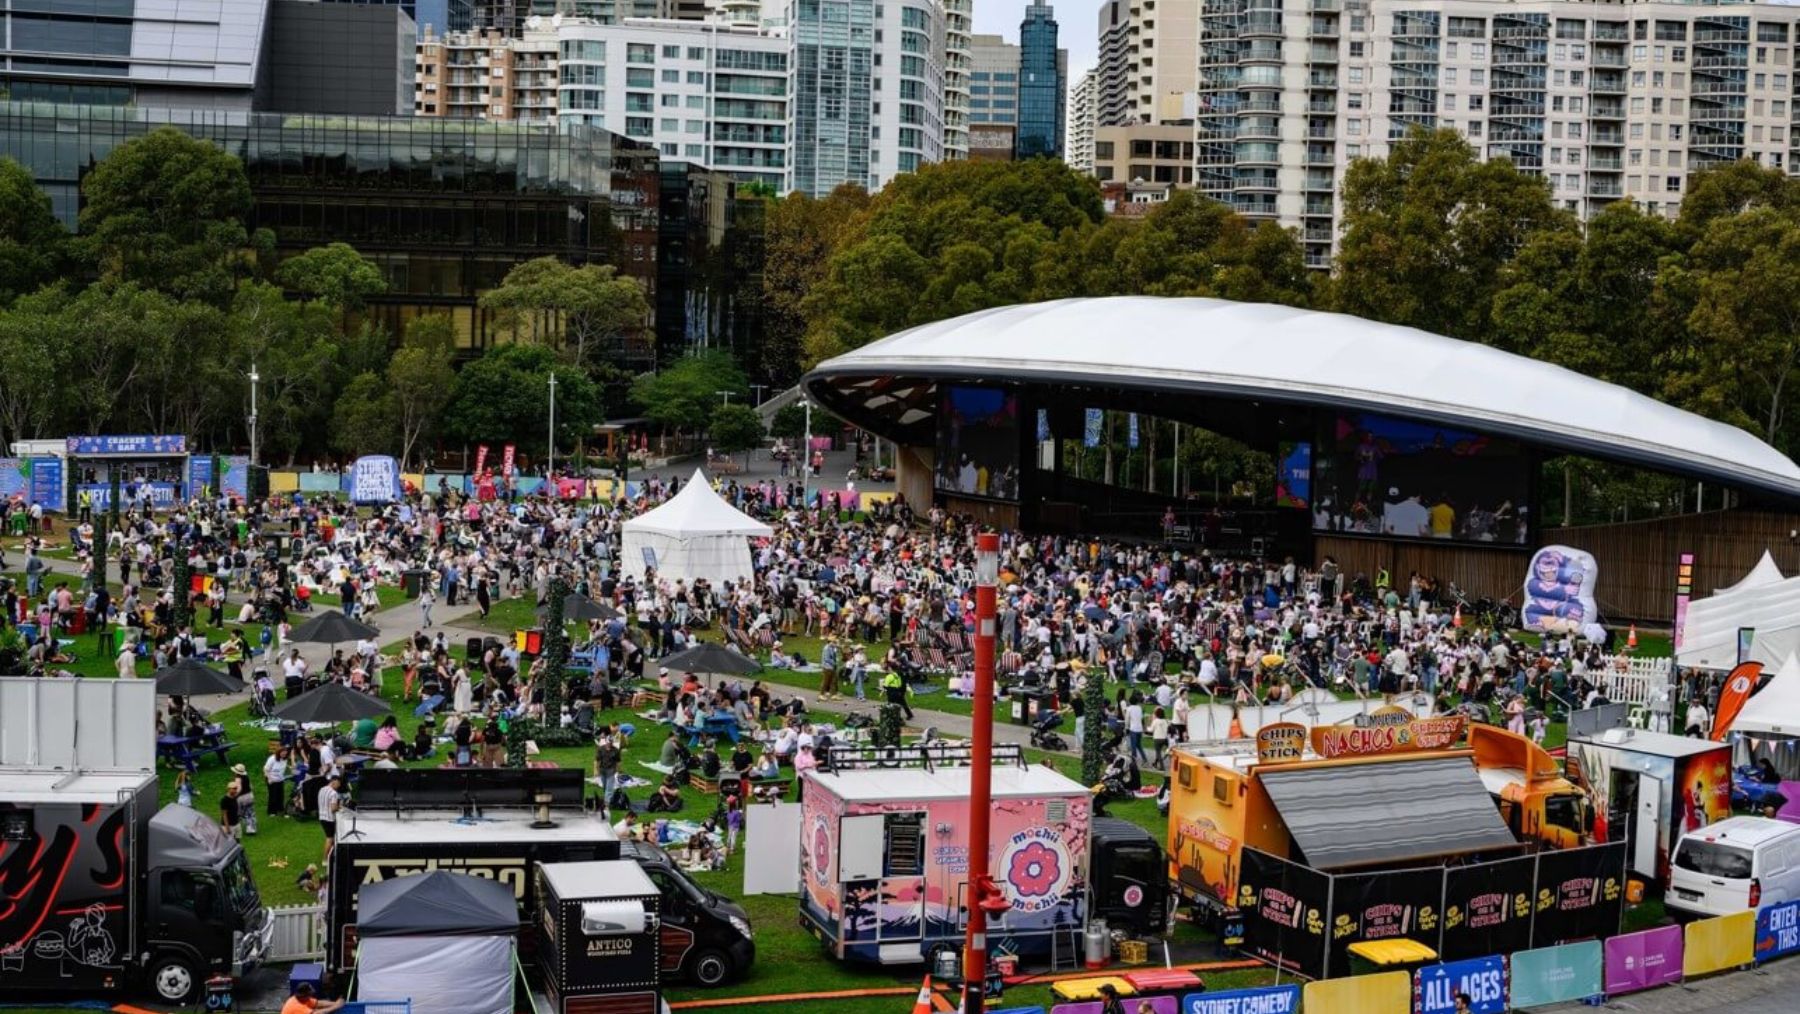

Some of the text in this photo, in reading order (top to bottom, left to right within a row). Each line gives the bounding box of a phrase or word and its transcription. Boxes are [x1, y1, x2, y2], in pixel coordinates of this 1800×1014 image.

[1261, 728, 1303, 740] CHIPS
[1323, 727, 1410, 757] NACHOS &
[1262, 748, 1302, 758] STICK
[1012, 828, 1060, 844] mochii
[1012, 892, 1059, 910] mochii
[1770, 904, 1797, 931] ENTER
[587, 939, 633, 950] ANTICO
[1778, 926, 1798, 951] THIS
[1425, 970, 1500, 1012] ALL AGES
[1193, 991, 1293, 1014] SYDNEY COMEDY
